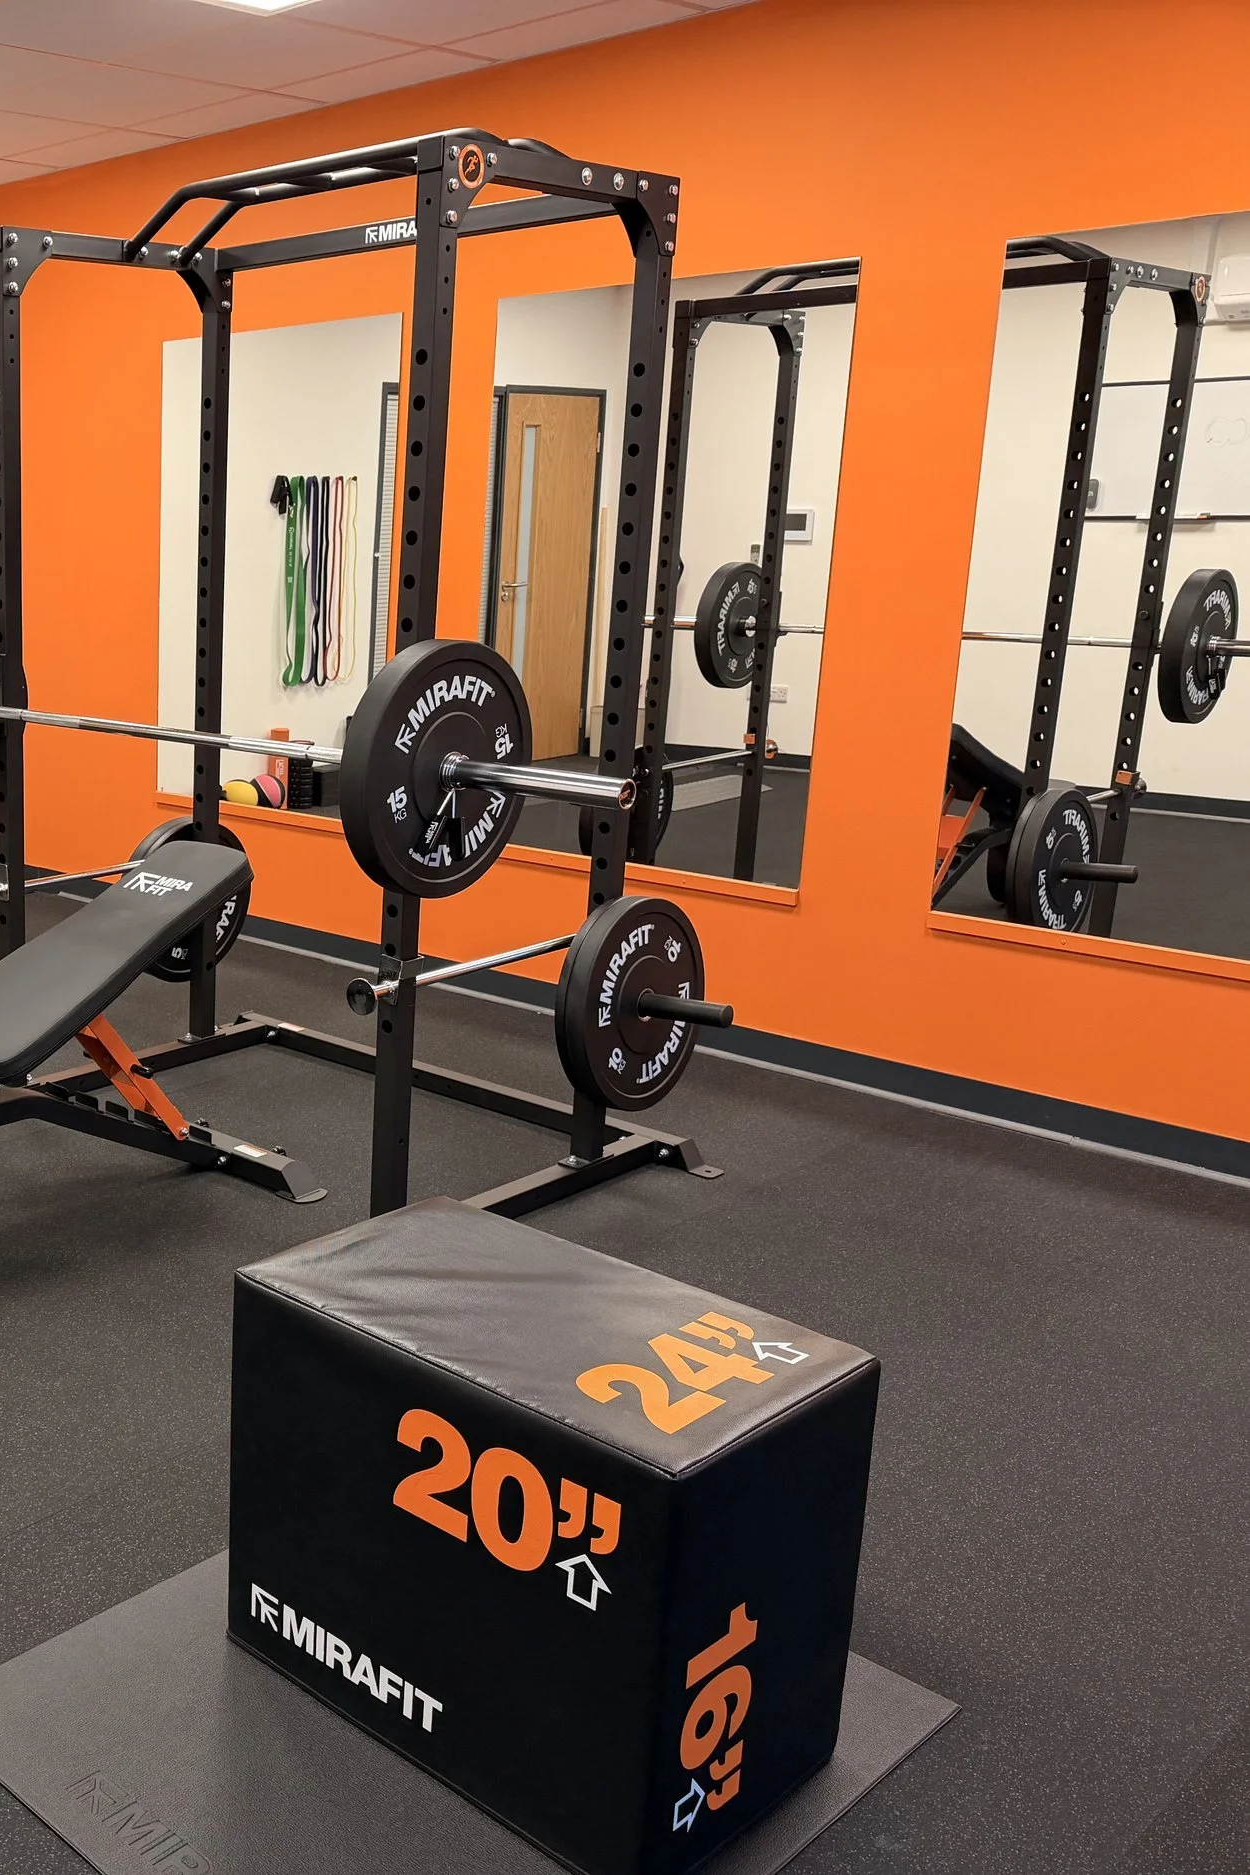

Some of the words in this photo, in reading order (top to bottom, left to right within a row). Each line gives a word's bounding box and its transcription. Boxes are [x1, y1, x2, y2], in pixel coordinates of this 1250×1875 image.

[378, 220, 417, 242] MIRA
[407, 675, 493, 732] MIRAFIT
[495, 722, 508, 738] KG
[494, 733, 514, 760] 15
[386, 785, 408, 813] 15
[394, 809, 408, 824] KG
[145, 885, 173, 897] FIT
[155, 876, 194, 892] MIRA
[171, 947, 183, 960] 5
[600, 924, 652, 1002] MIRAFIT
[667, 940, 682, 963] 10
[608, 1047, 622, 1070] 10
[283, 1604, 443, 1733] MIRAFIT
